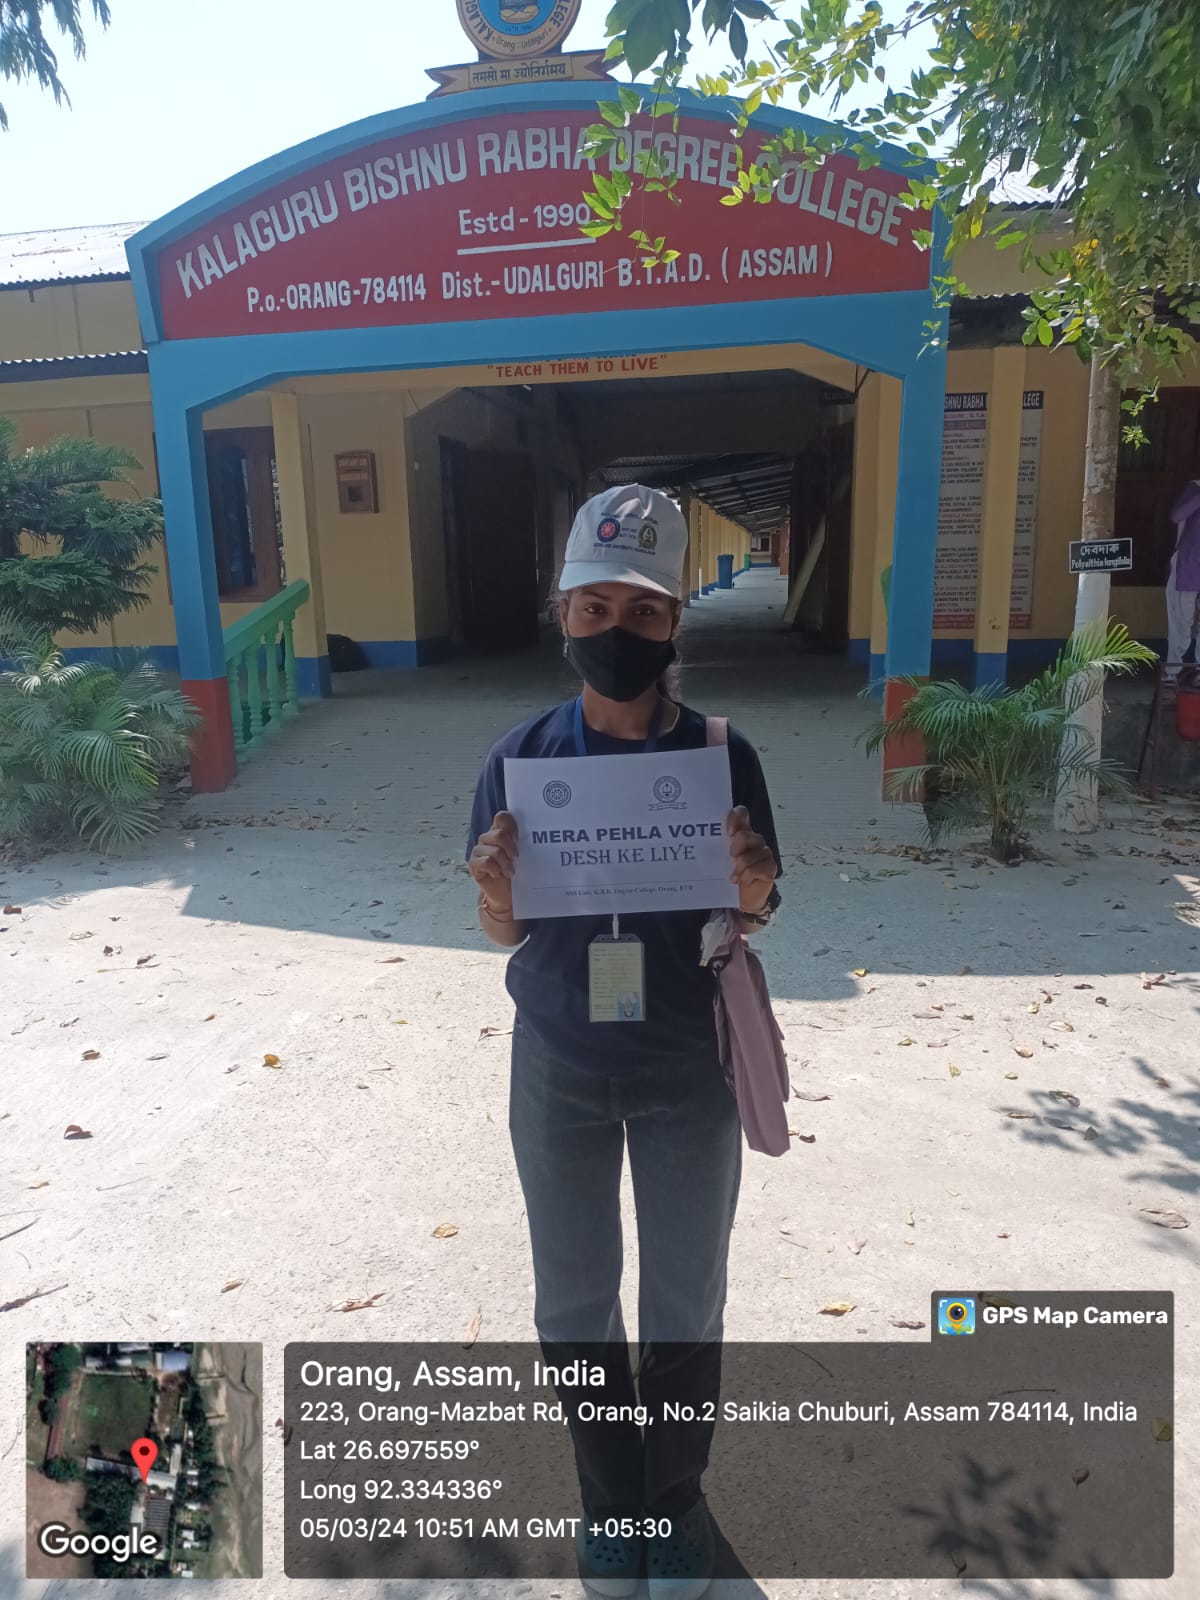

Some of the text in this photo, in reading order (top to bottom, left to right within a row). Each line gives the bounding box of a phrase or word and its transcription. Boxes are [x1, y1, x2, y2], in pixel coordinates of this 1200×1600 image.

[500, 67, 511, 81] मा
[175, 178, 339, 298] KALAGURU
[343, 137, 467, 212] BISHNU
[477, 126, 597, 177] RABHA
[608, 129, 738, 189] DEGREE
[550, 361, 589, 376] THEM
[596, 359, 614, 373] TO
[944, 394, 962, 409] SHNU
[1023, 392, 1040, 407] LEGE
[532, 822, 722, 845] MERA PEHLA VOTE
[560, 843, 696, 867] DESH KE LIYE
